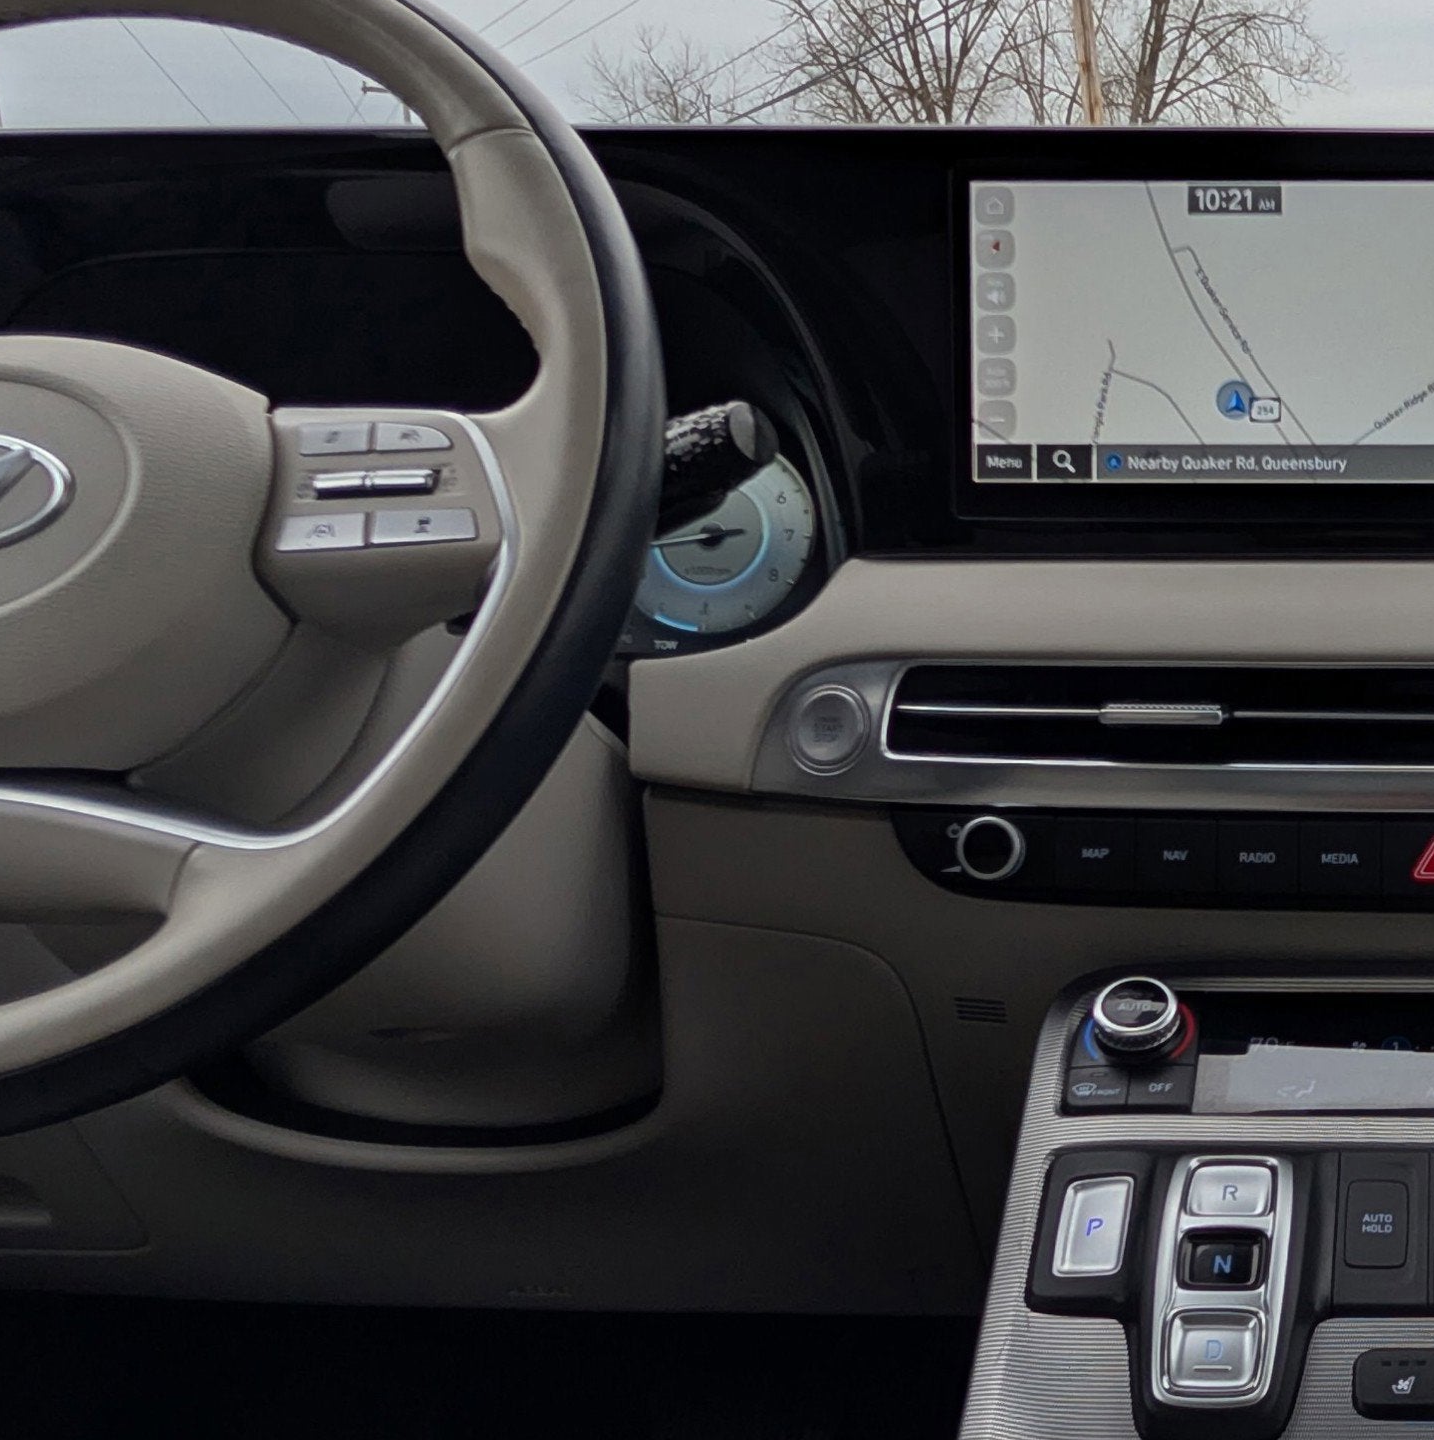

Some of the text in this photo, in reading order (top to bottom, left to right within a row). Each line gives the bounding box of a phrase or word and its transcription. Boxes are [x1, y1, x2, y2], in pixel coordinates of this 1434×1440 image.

[1194, 188, 1275, 211] 10:21 AM
[1373, 407, 1403, 429] Quaker
[986, 455, 1022, 468] Menu
[1128, 456, 1178, 472] Nearby
[1182, 456, 1231, 471] Quaker
[1262, 456, 1348, 472] Queensbury
[776, 491, 787, 505] 6
[784, 529, 794, 541] 7
[1081, 847, 1109, 859] MAP
[1163, 849, 1189, 861] NAV
[1239, 852, 1276, 864] RADIO
[1321, 853, 1359, 865] MEDIA
[1148, 1082, 1173, 1093] OFF
[1222, 1184, 1238, 1201] R
[1362, 1213, 1393, 1224] AUTO
[1086, 1217, 1103, 1237] P
[1362, 1223, 1393, 1234] HOLD
[1213, 1255, 1232, 1274] N
[1205, 1339, 1223, 1360] D
